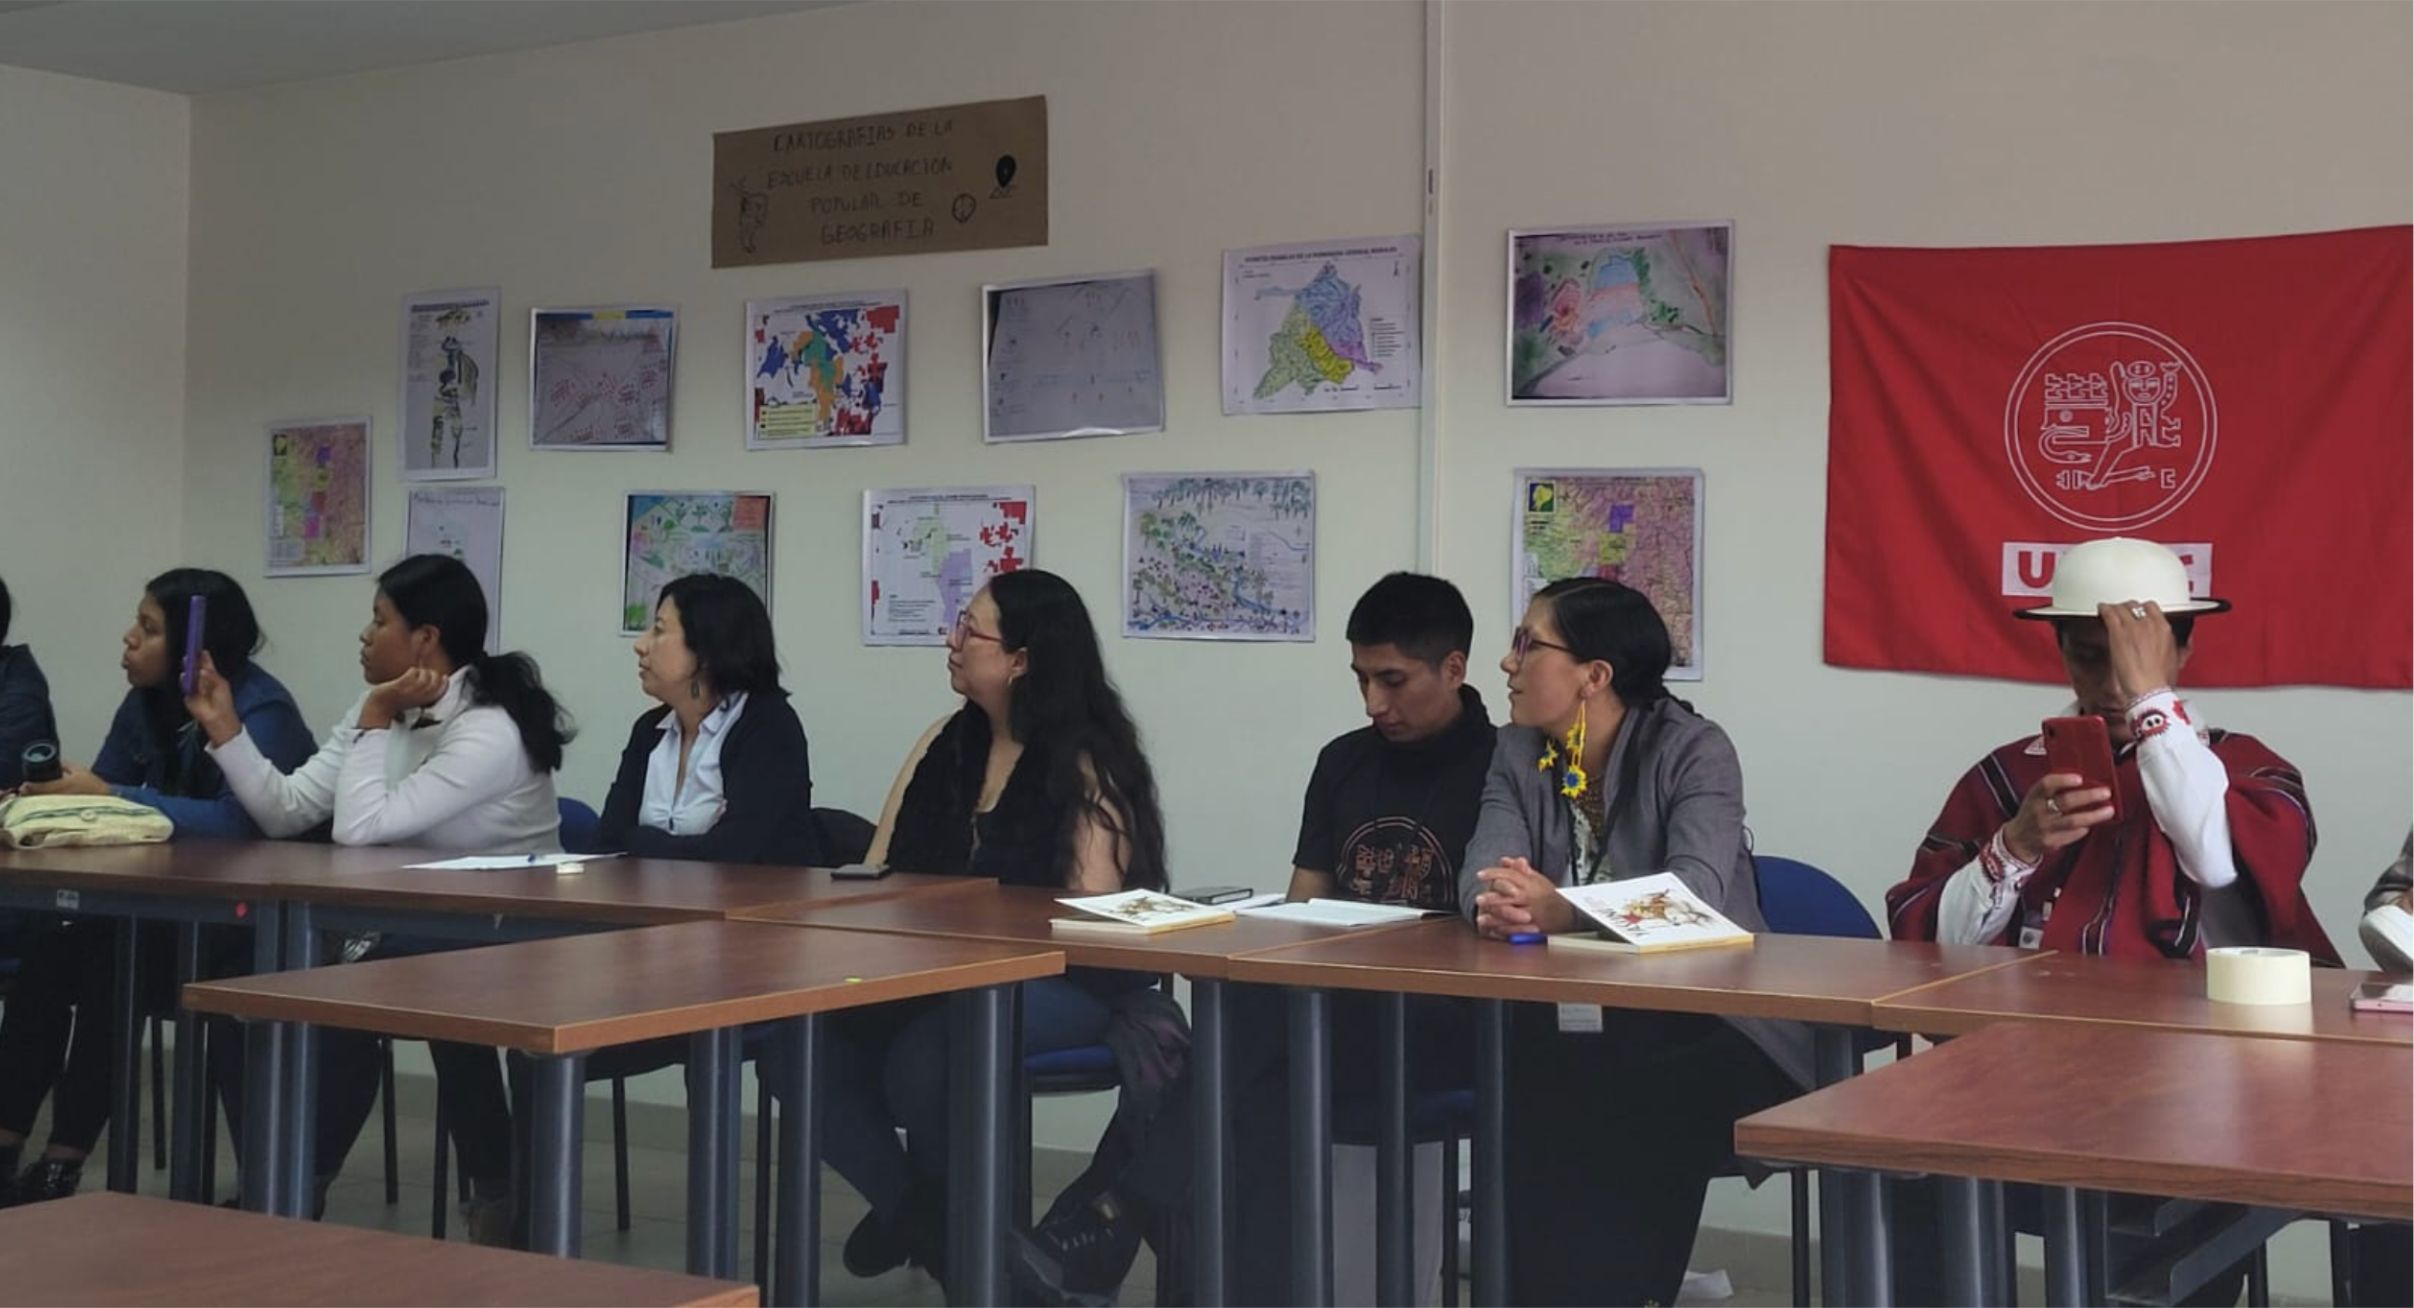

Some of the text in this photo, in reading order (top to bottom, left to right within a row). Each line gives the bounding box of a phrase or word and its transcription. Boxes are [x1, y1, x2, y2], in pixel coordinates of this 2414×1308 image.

[906, 122, 925, 137] DE
[935, 119, 953, 136] LA
[767, 164, 832, 190] ESCUELA
[842, 164, 860, 182] DE
[811, 191, 923, 214] POPULAR DE
[821, 216, 935, 244] GEOGRAFIA
